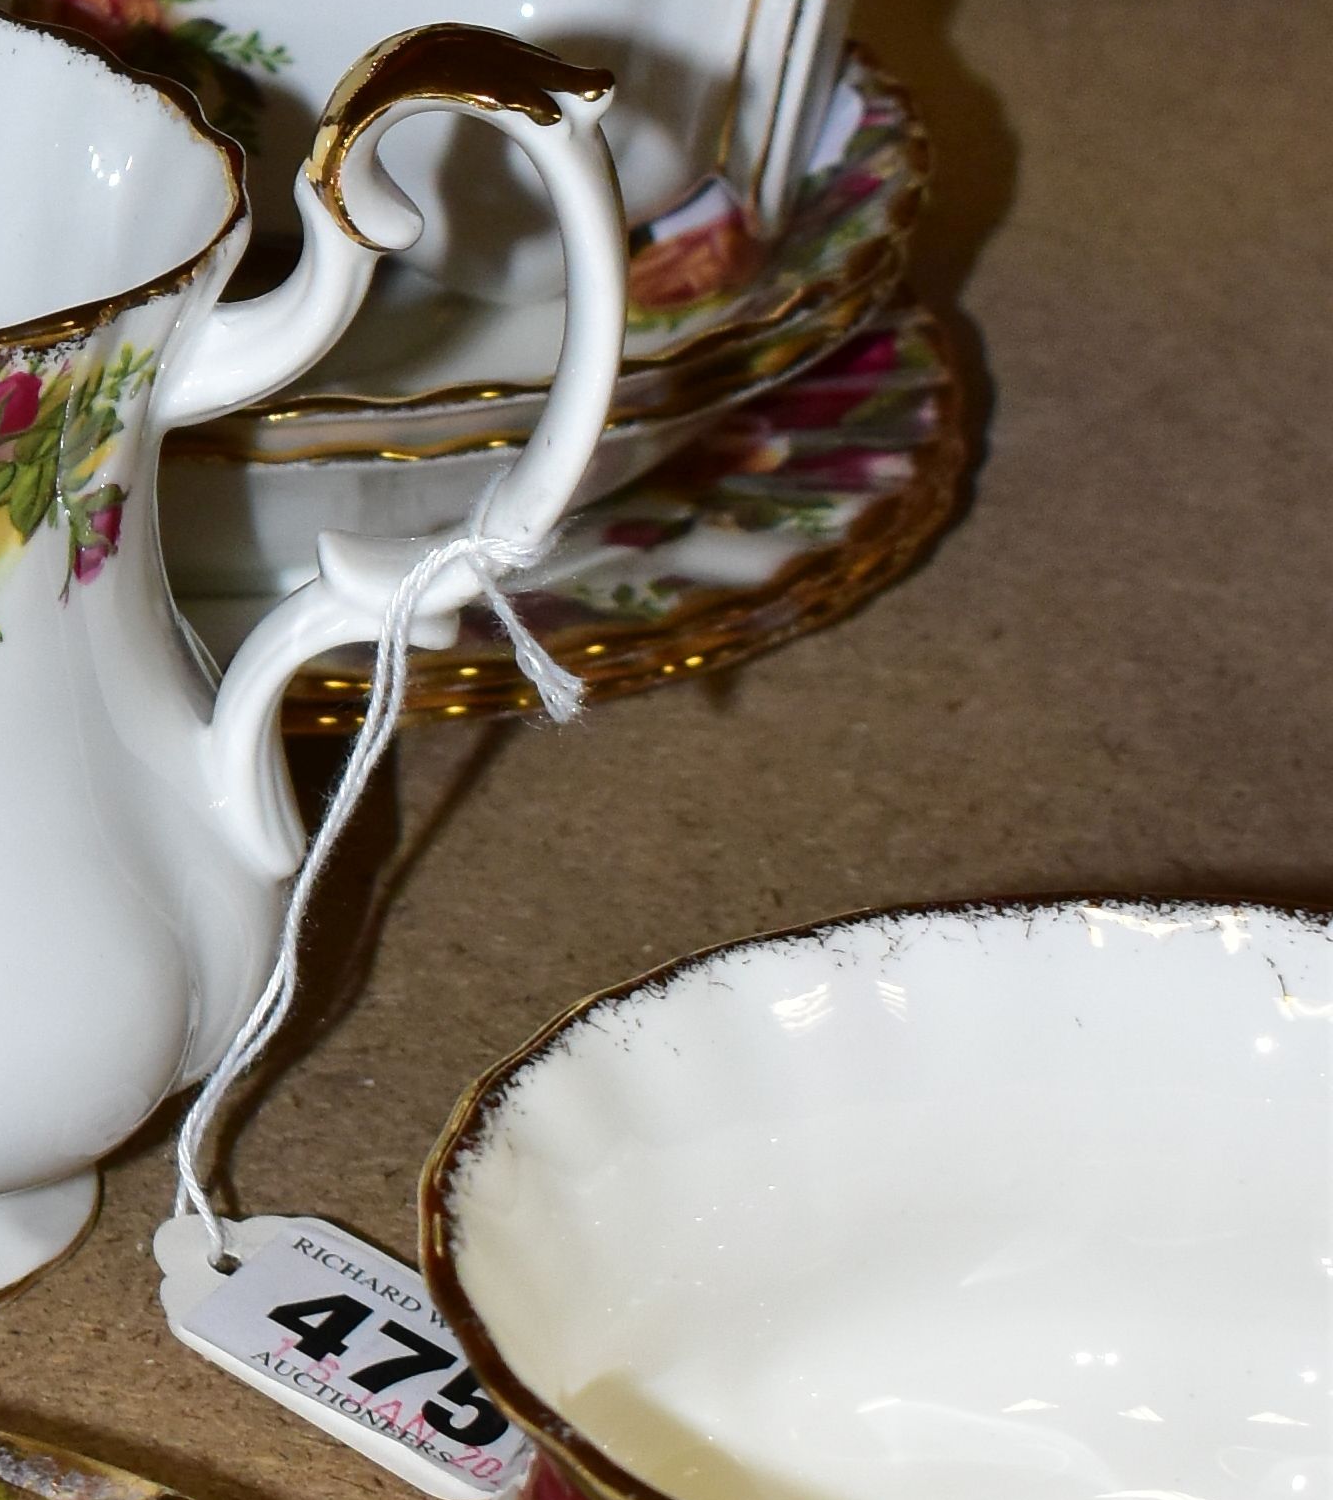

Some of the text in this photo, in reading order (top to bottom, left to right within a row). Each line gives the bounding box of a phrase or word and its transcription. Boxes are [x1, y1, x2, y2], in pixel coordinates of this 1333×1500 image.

[292, 1236, 422, 1313] RICHARD
[250, 1350, 453, 1464] AUCTIONEERS
[267, 1294, 509, 1446] 475
[450, 1445, 503, 1487] 20
